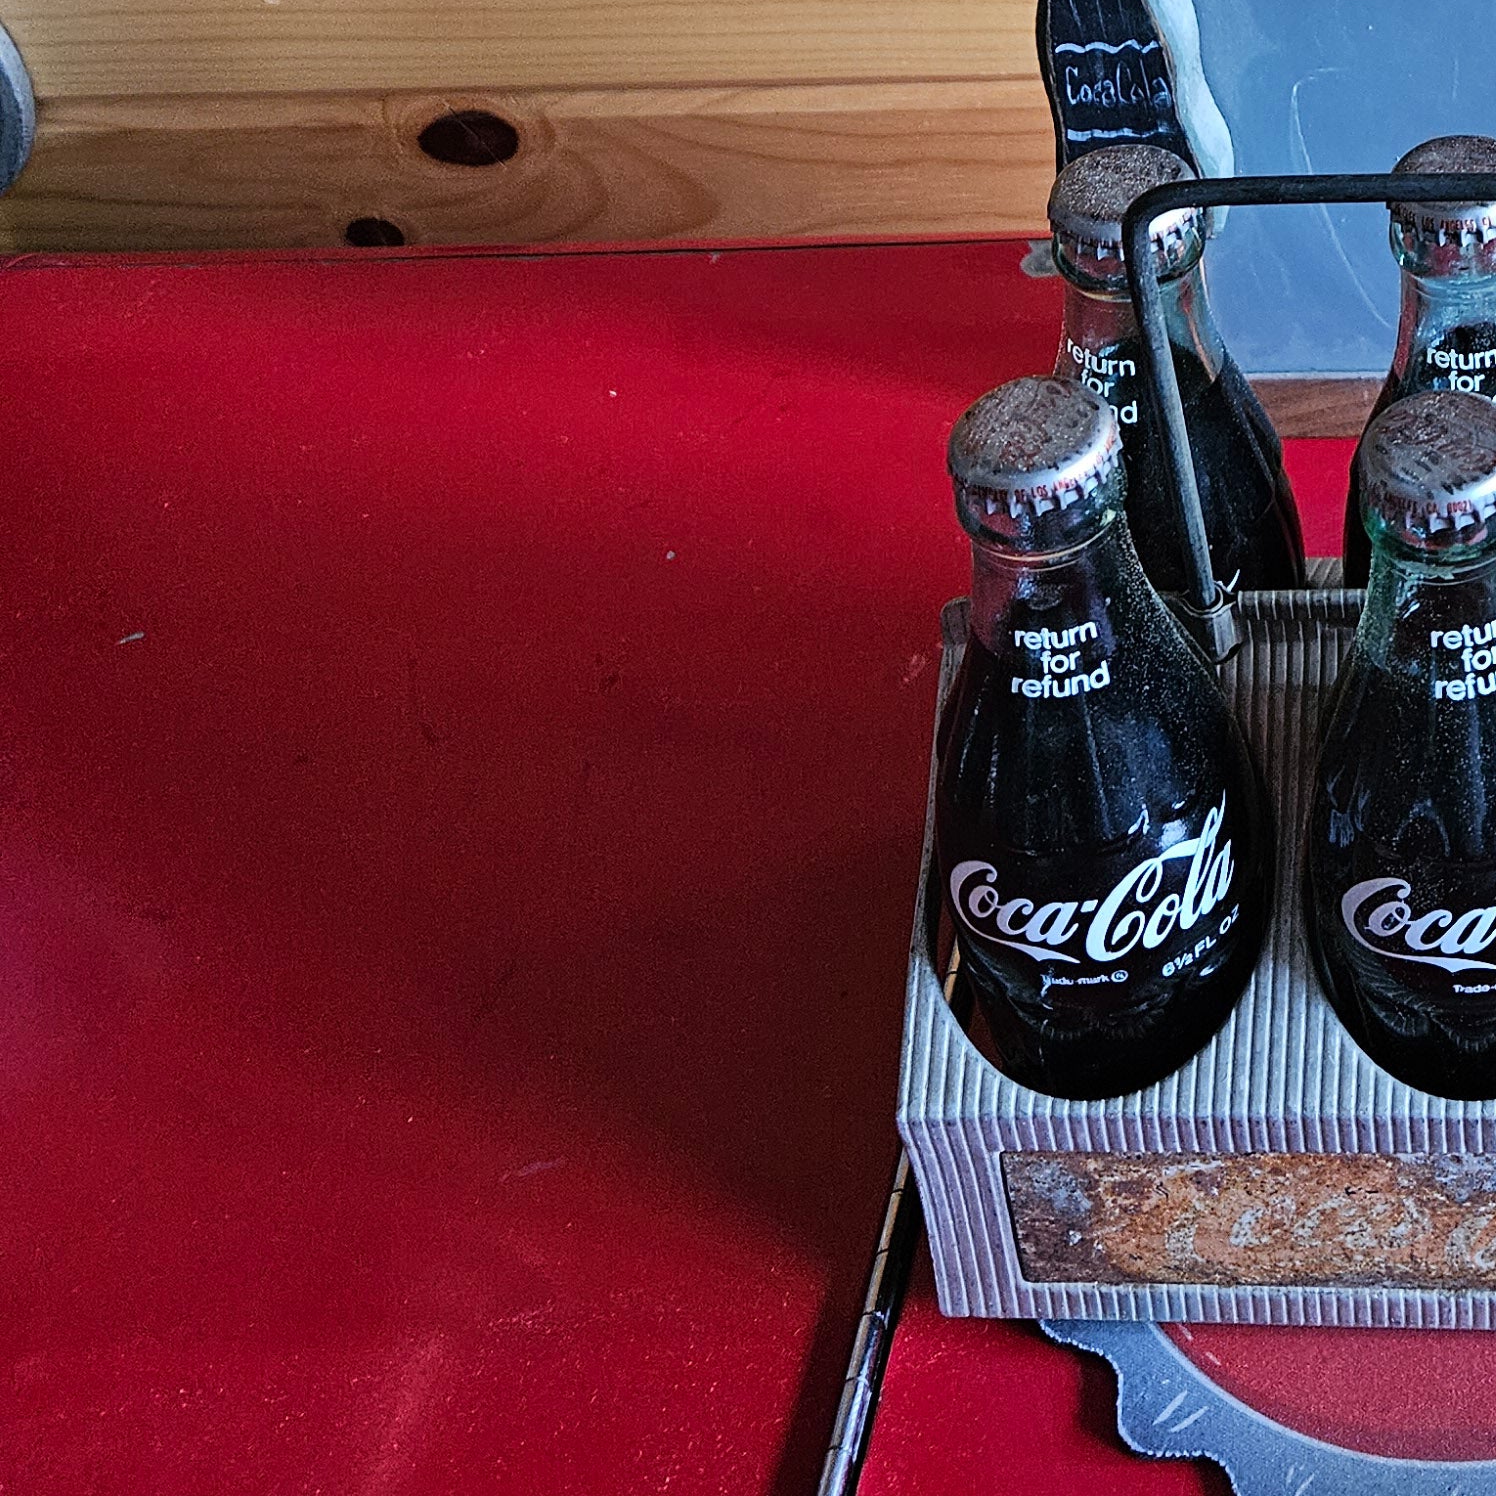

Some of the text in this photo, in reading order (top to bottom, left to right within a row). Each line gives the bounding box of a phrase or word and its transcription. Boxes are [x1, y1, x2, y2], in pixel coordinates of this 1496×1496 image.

[1067, 338, 1136, 376] return
[1081, 368, 1115, 398] for
[1448, 369, 1486, 393] for
[1014, 620, 1098, 651] return
[1040, 650, 1082, 675] for
[1011, 661, 1111, 699] refund
[950, 788, 1235, 964] Coca-Cola
